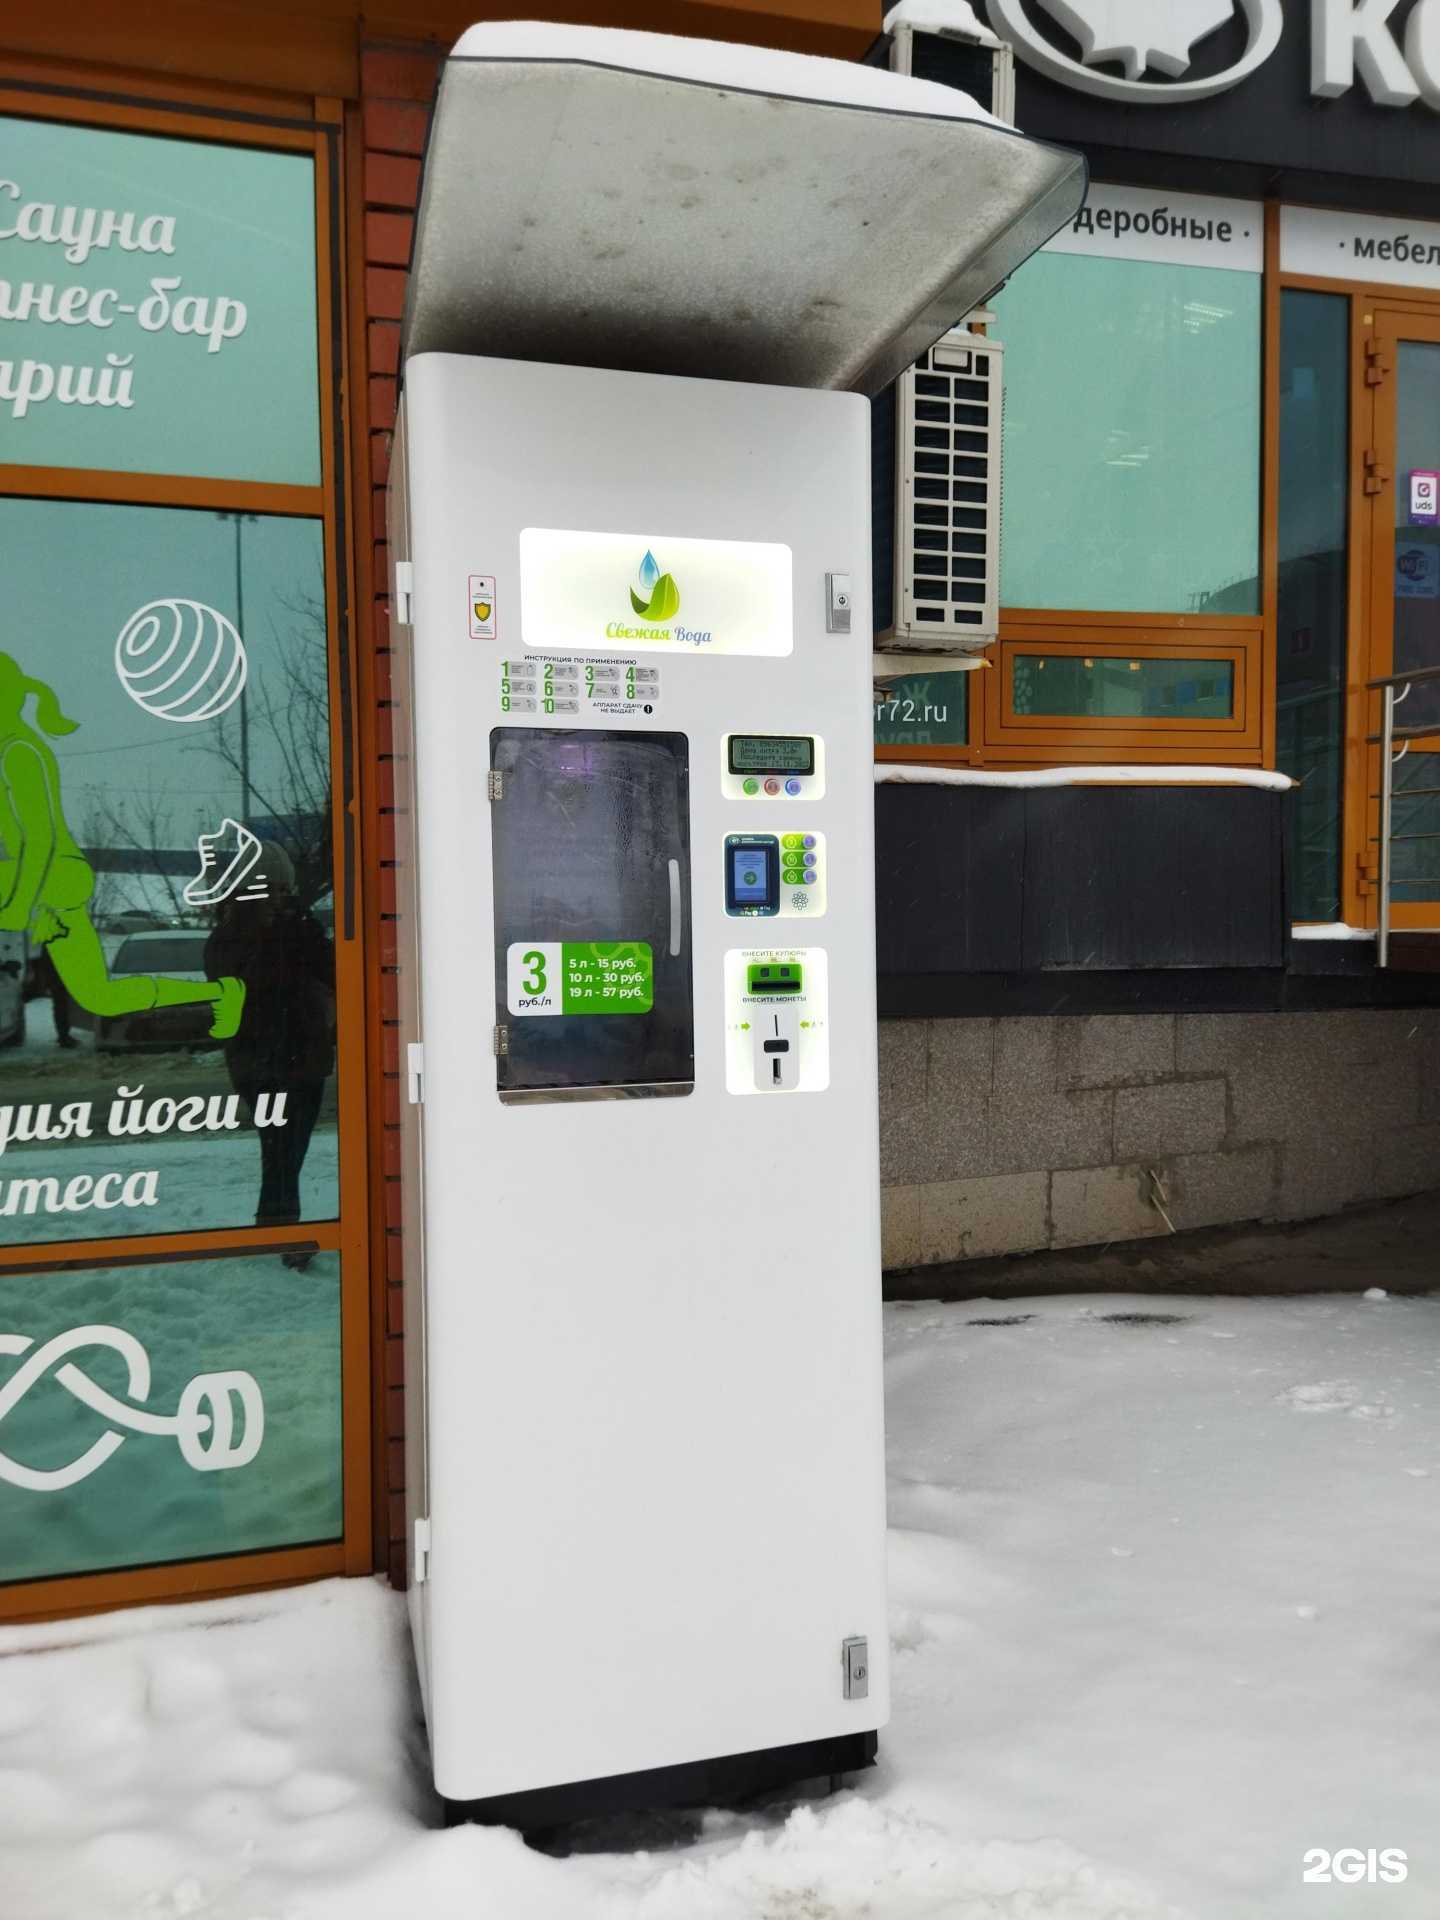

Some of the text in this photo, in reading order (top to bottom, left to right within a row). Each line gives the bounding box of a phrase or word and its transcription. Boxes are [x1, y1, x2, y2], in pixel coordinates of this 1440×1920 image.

[1073, 206, 1232, 243] деробные
[1354, 233, 1440, 266] мебел
[606, 622, 713, 646] Свежая Вода
[524, 655, 572, 663] ИНСТРУКЦИЯ
[586, 657, 637, 666] ПРИМЕНЕНИЮ
[501, 661, 510, 677] 1
[544, 663, 554, 679] 2
[585, 665, 594, 682] 3
[626, 666, 635, 682] 4
[501, 678, 510, 694] 5
[544, 680, 554, 697] 6
[585, 683, 594, 698] 7
[626, 684, 635, 699] 8
[501, 697, 510, 712] 9
[541, 699, 554, 714] 10
[569, 959, 577, 968] 5
[599, 959, 609, 968] 15
[612, 958, 637, 970] руб.
[522, 951, 547, 996] 3
[569, 973, 582, 982] 10
[603, 973, 618, 982] 30
[620, 972, 645, 984] руб.
[569, 988, 582, 997] 19
[603, 988, 616, 997] 57
[619, 987, 644, 999] руб.
[519, 996, 551, 1008] руб./л
[107, 1084, 241, 1137] йоги
[253, 1092, 289, 1127] и
[0, 1170, 160, 1216] теса
